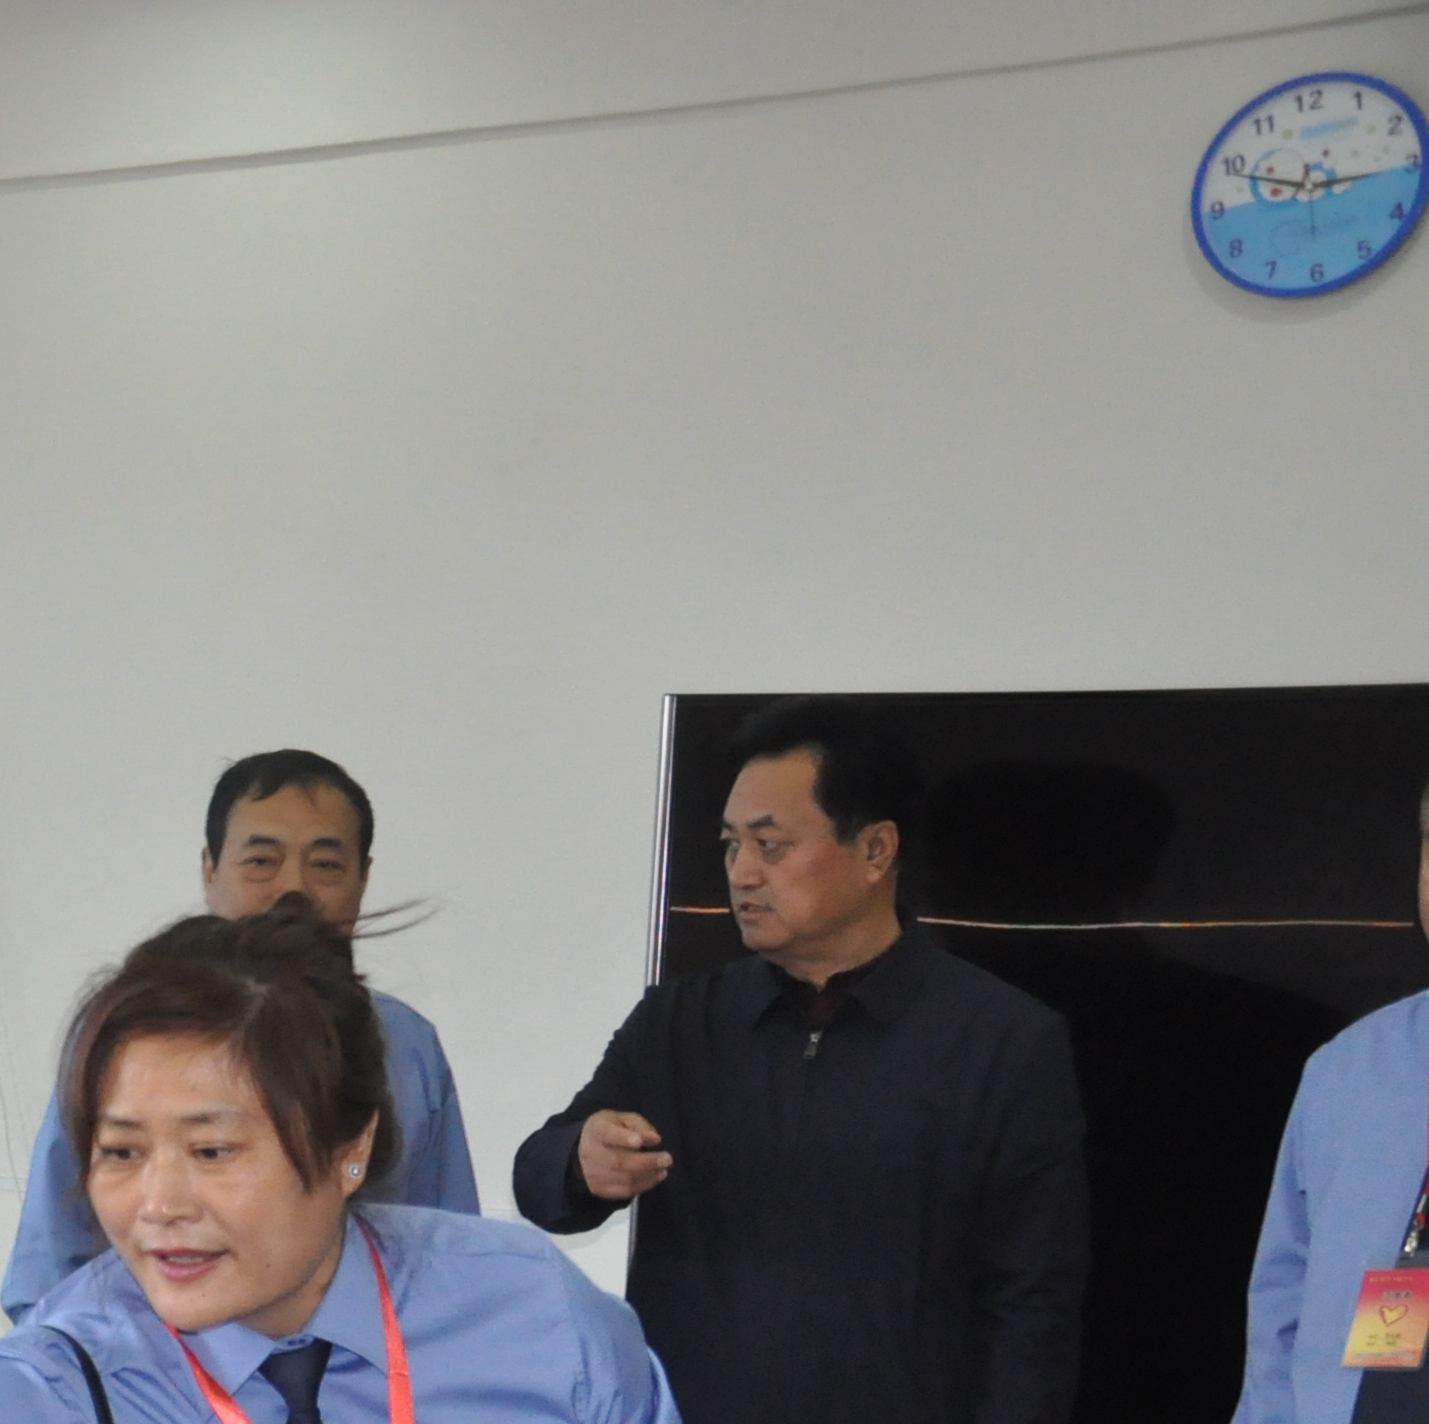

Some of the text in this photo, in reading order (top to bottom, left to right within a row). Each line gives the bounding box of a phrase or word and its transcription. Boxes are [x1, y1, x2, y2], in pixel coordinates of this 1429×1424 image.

[1294, 90, 1324, 112] 12
[1353, 91, 1363, 110] 1
[1253, 115, 1275, 135] 11
[1387, 115, 1403, 136] 2
[1222, 155, 1246, 176] 10
[1405, 153, 1420, 174] 3
[1209, 201, 1225, 220] 9
[1390, 202, 1406, 220] 4
[1229, 239, 1243, 258] 8
[1357, 240, 1371, 259] 5
[1265, 261, 1278, 280] 7
[1310, 263, 1324, 282] 6
